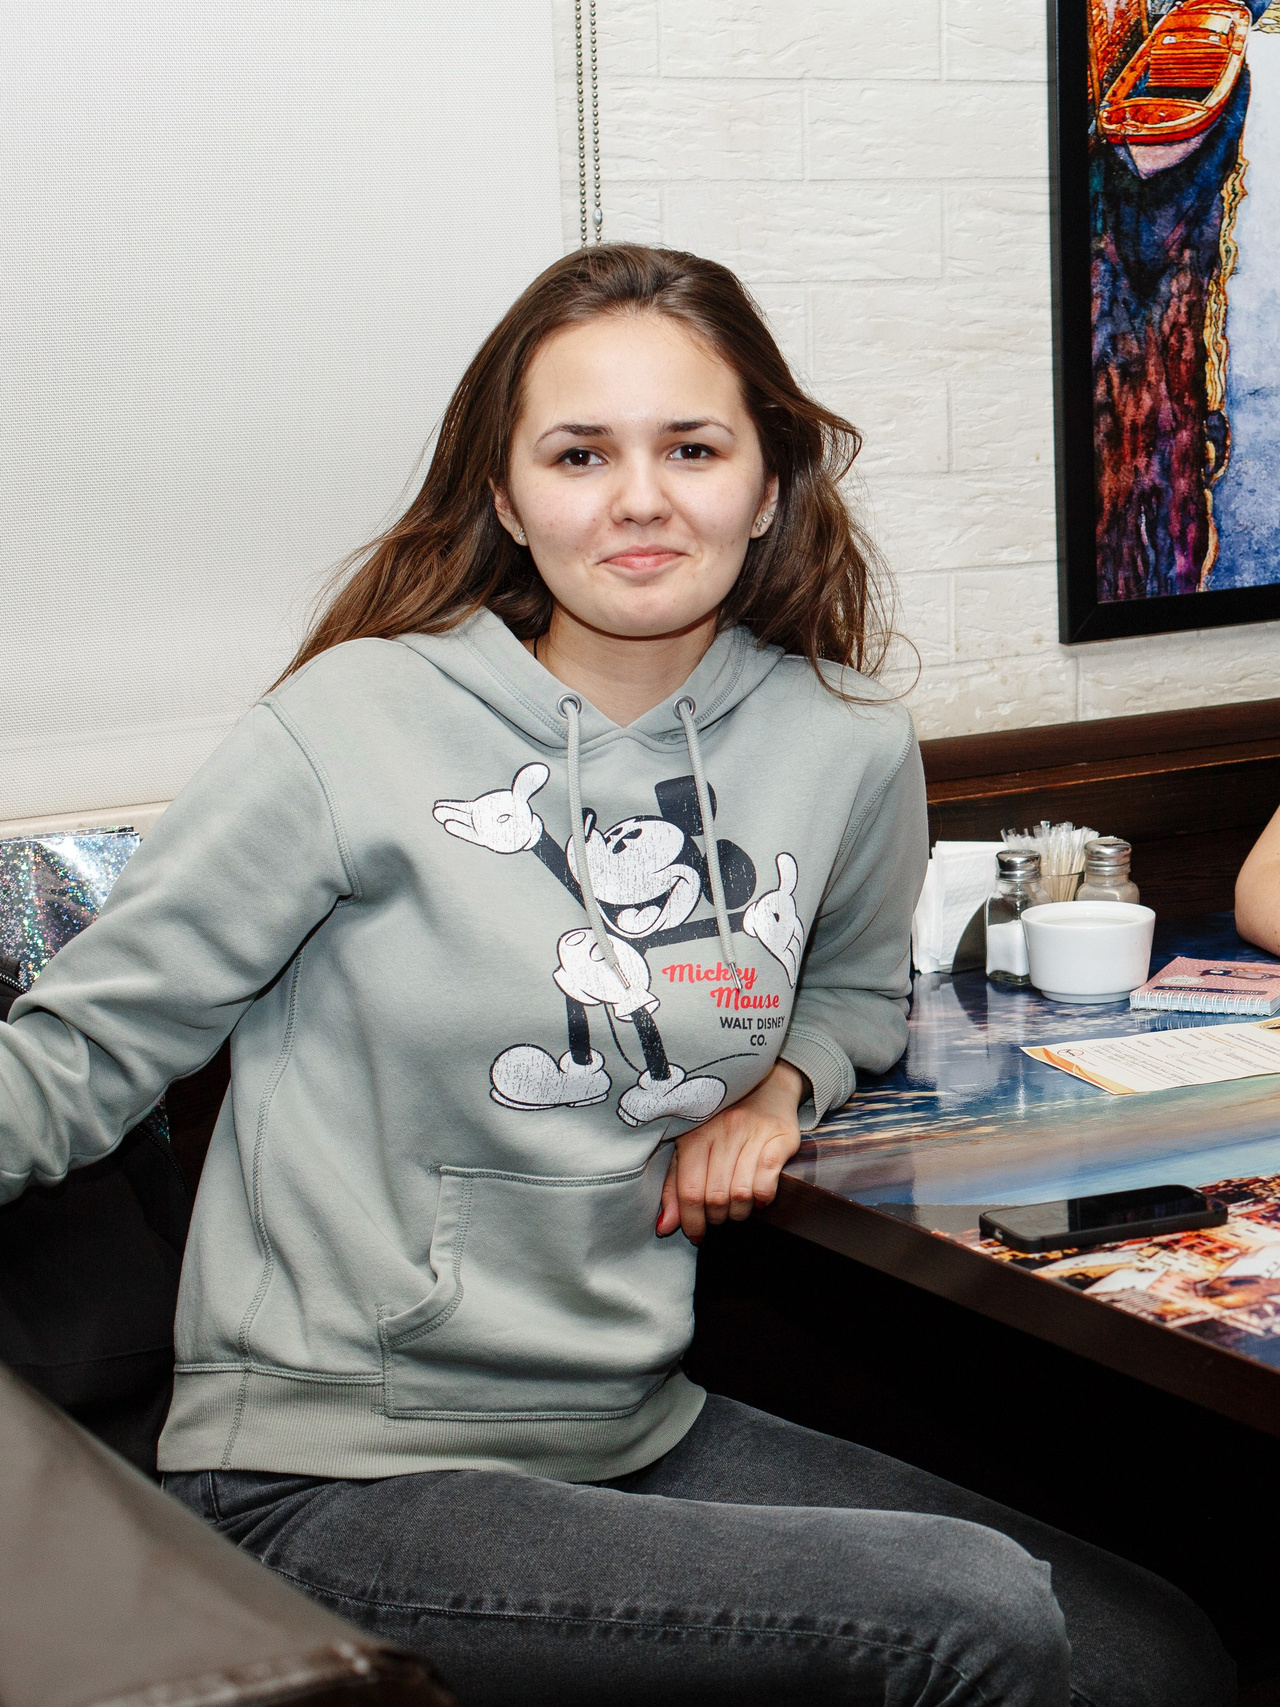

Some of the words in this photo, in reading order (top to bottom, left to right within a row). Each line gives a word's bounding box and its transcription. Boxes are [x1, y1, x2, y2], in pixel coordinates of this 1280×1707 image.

[709, 987, 780, 1011] Mouse
[719, 1016, 754, 1030] WALT
[757, 1016, 786, 1030] DISNEY
[749, 1034, 768, 1047] CO.
